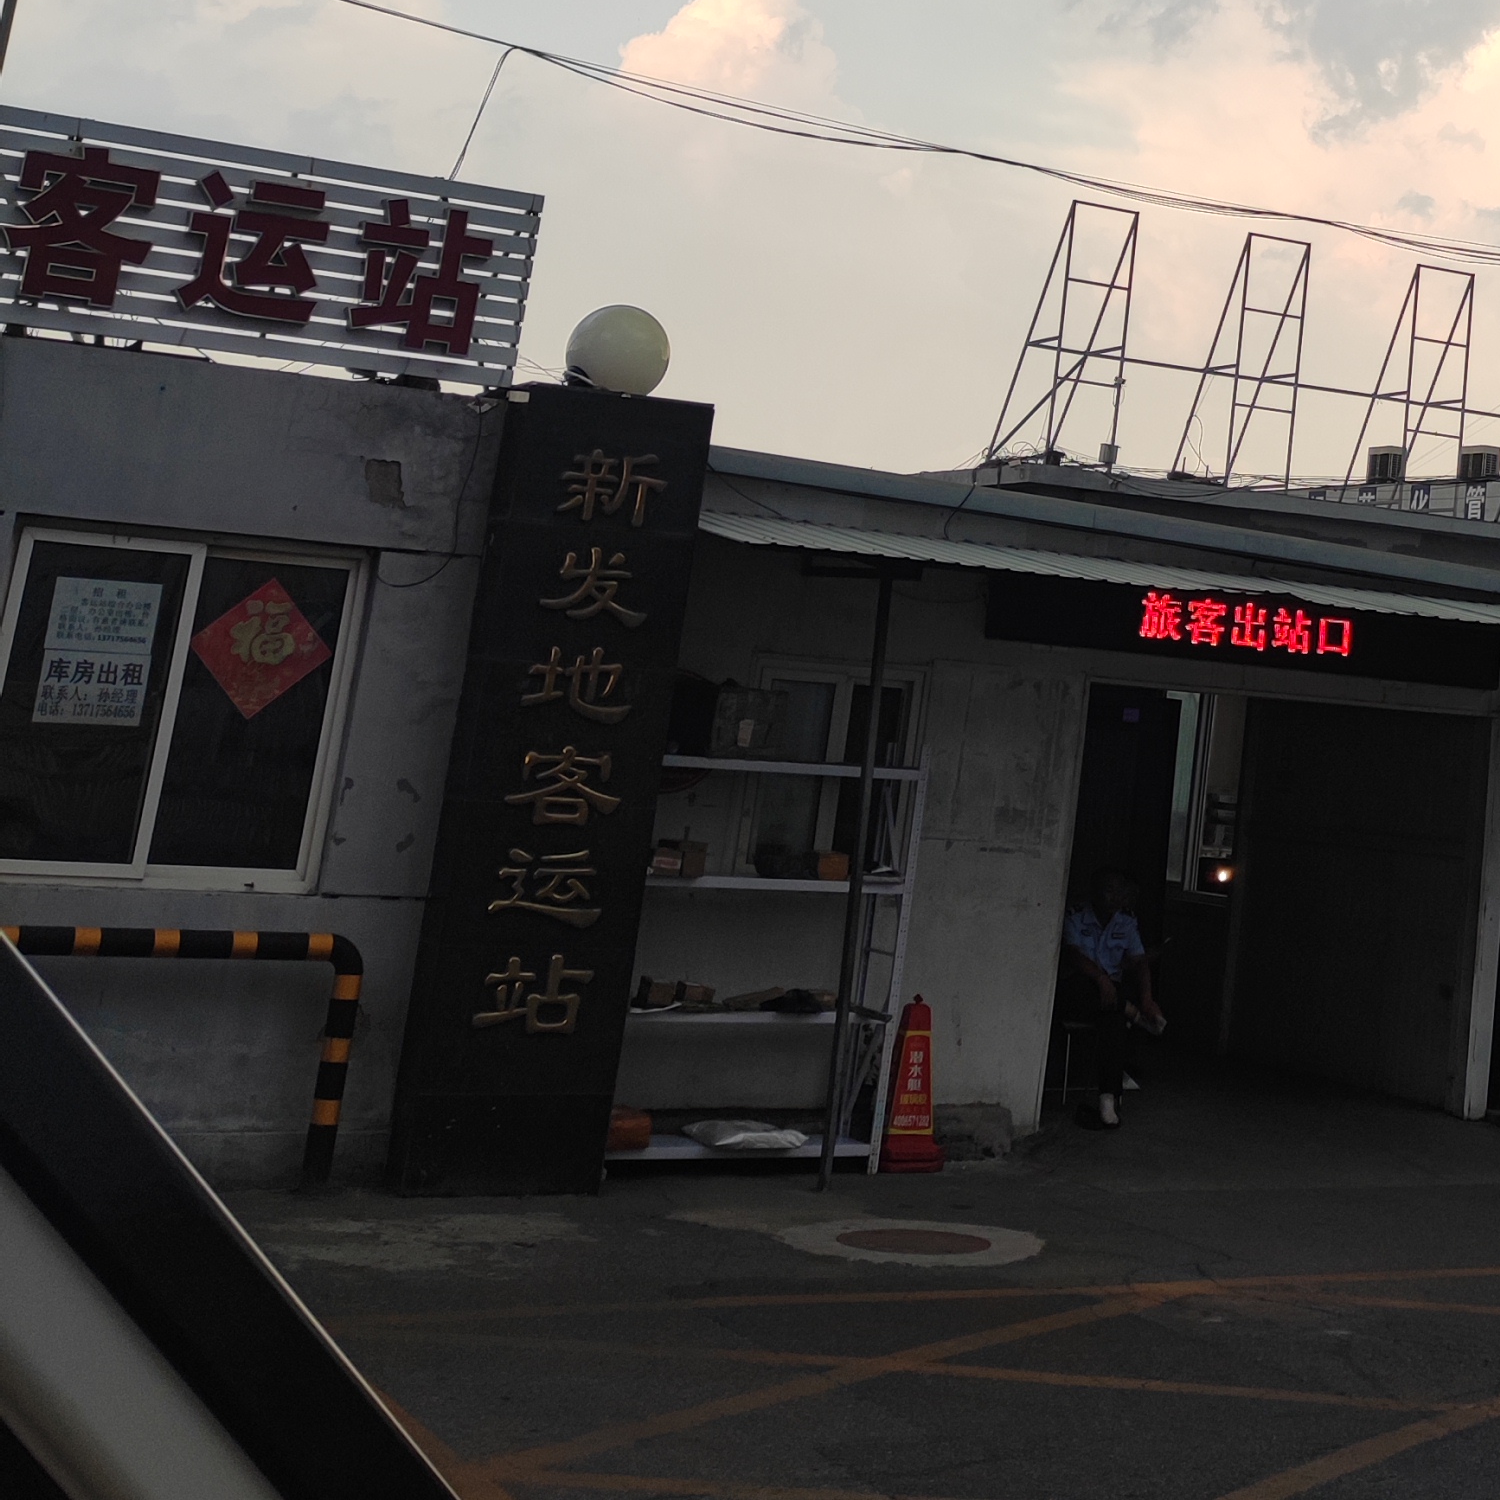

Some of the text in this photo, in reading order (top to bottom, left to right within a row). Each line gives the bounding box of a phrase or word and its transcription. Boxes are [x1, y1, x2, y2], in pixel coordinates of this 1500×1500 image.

[3, 148, 494, 356] 客运站
[230, 599, 295, 665] 福
[1139, 592, 1352, 656] 旅客出站口
[41, 685, 138, 704] 联系人：孙经理
[44, 658, 143, 686] 库房出租
[472, 447, 668, 1035] 新发地客运站
[906, 1051, 925, 1092] 潜水艇
